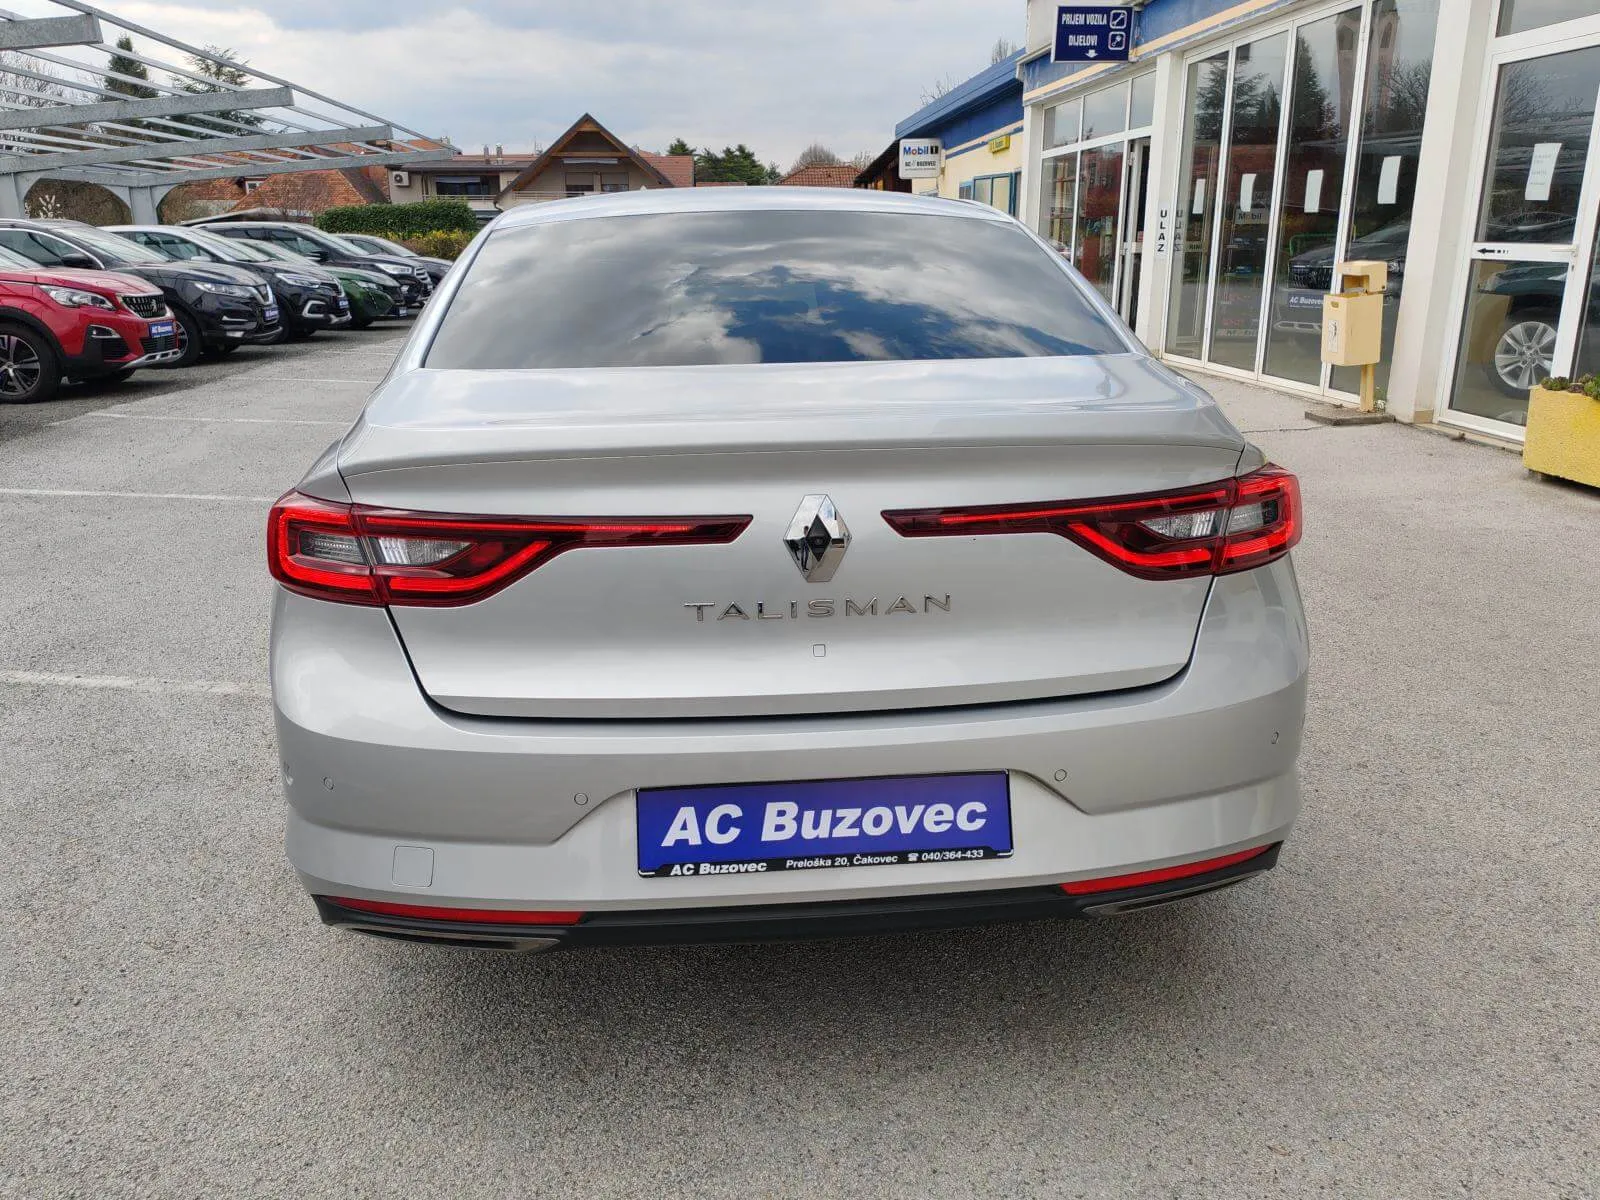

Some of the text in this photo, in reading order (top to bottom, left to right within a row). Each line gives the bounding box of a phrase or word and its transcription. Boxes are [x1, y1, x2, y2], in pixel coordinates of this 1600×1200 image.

[1062, 13, 1107, 25] PRIJEM VOZILA
[1068, 34, 1098, 46] DIJELOVI
[903, 146, 929, 155] Mobil
[1157, 209, 1168, 252] ULAZ
[1300, 296, 1323, 305] Buzove
[683, 592, 952, 622] TALISMAN
[661, 801, 988, 847] AC Buzovec
[670, 849, 984, 876] AC Buzovec Preloška 20, Čakovec 040/364-433
